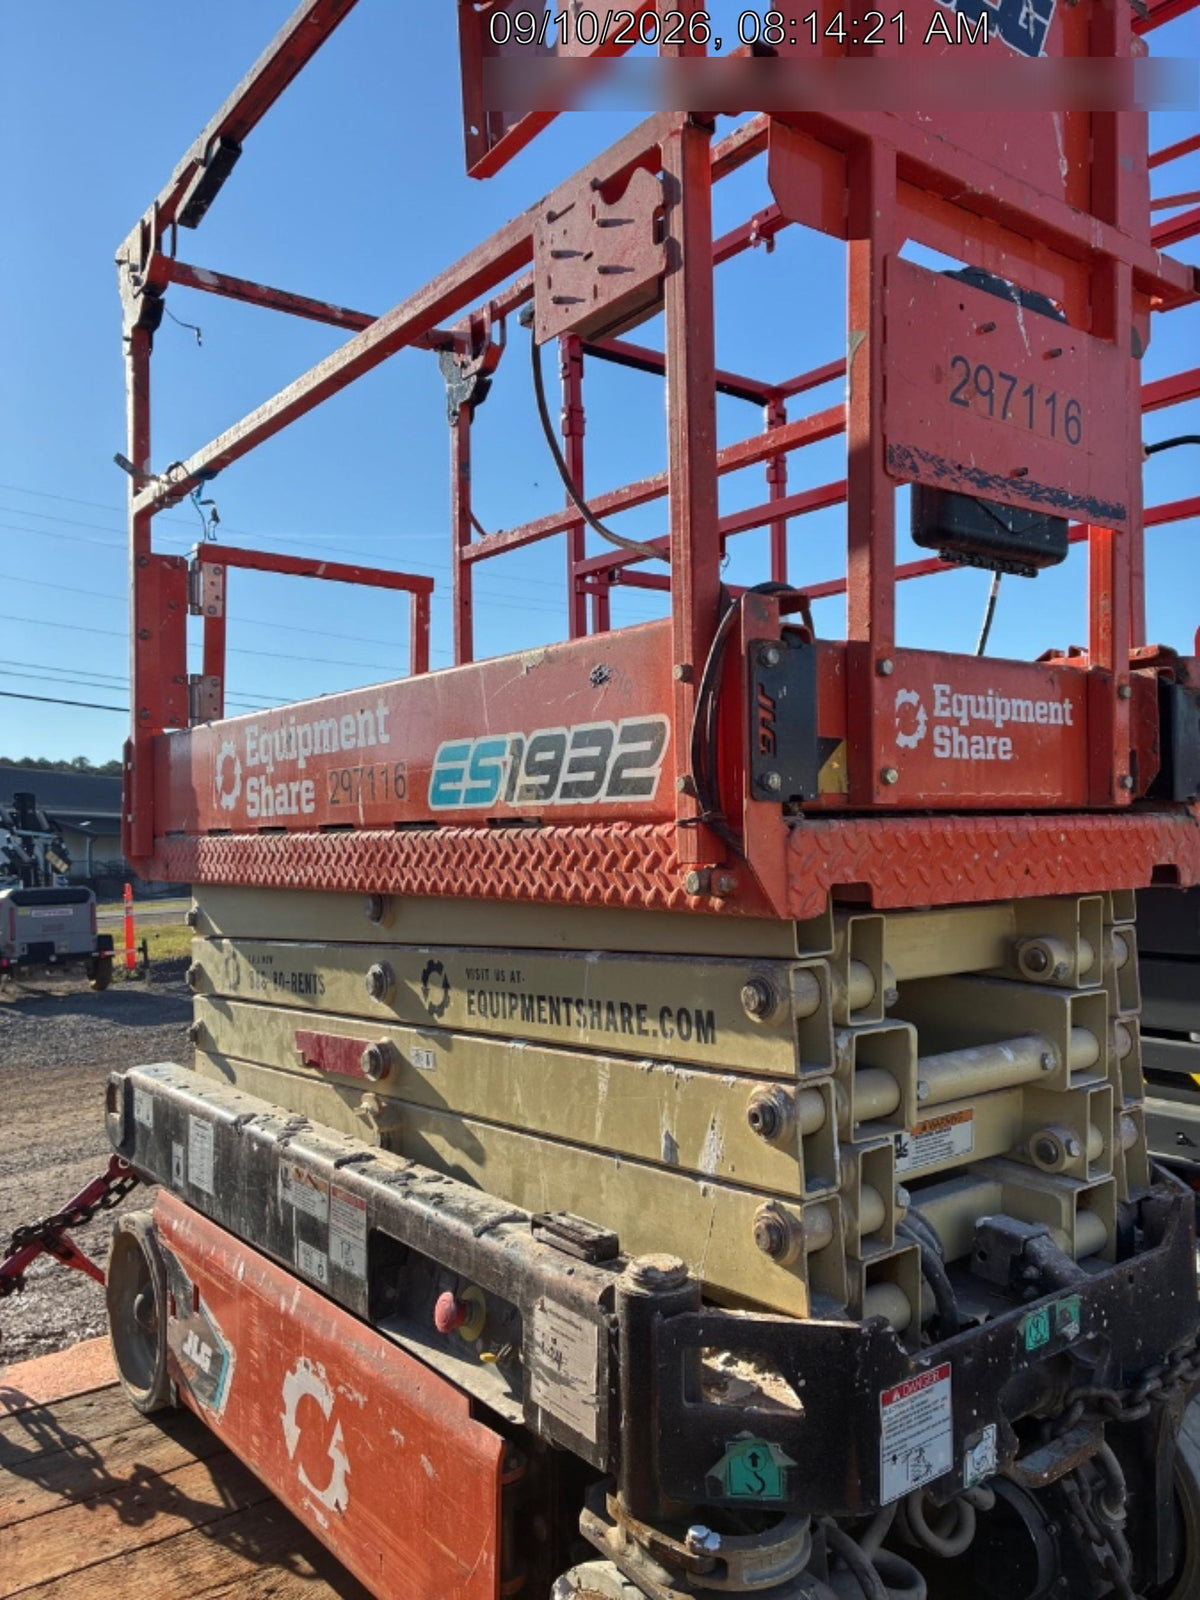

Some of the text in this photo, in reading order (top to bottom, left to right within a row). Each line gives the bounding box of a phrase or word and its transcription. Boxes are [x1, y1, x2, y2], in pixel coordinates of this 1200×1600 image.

[950, 355, 1082, 445] 297116
[933, 683, 1073, 728] Equipment
[245, 700, 390, 773] Equipment
[933, 725, 1014, 761] Share
[328, 761, 407, 805] 297116
[429, 714, 670, 810] ES1932
[246, 775, 315, 818] Share
[465, 967, 489, 981] VISIT
[494, 968, 506, 982] US
[466, 988, 717, 1045] EQUIPMENTSHARE.COM
